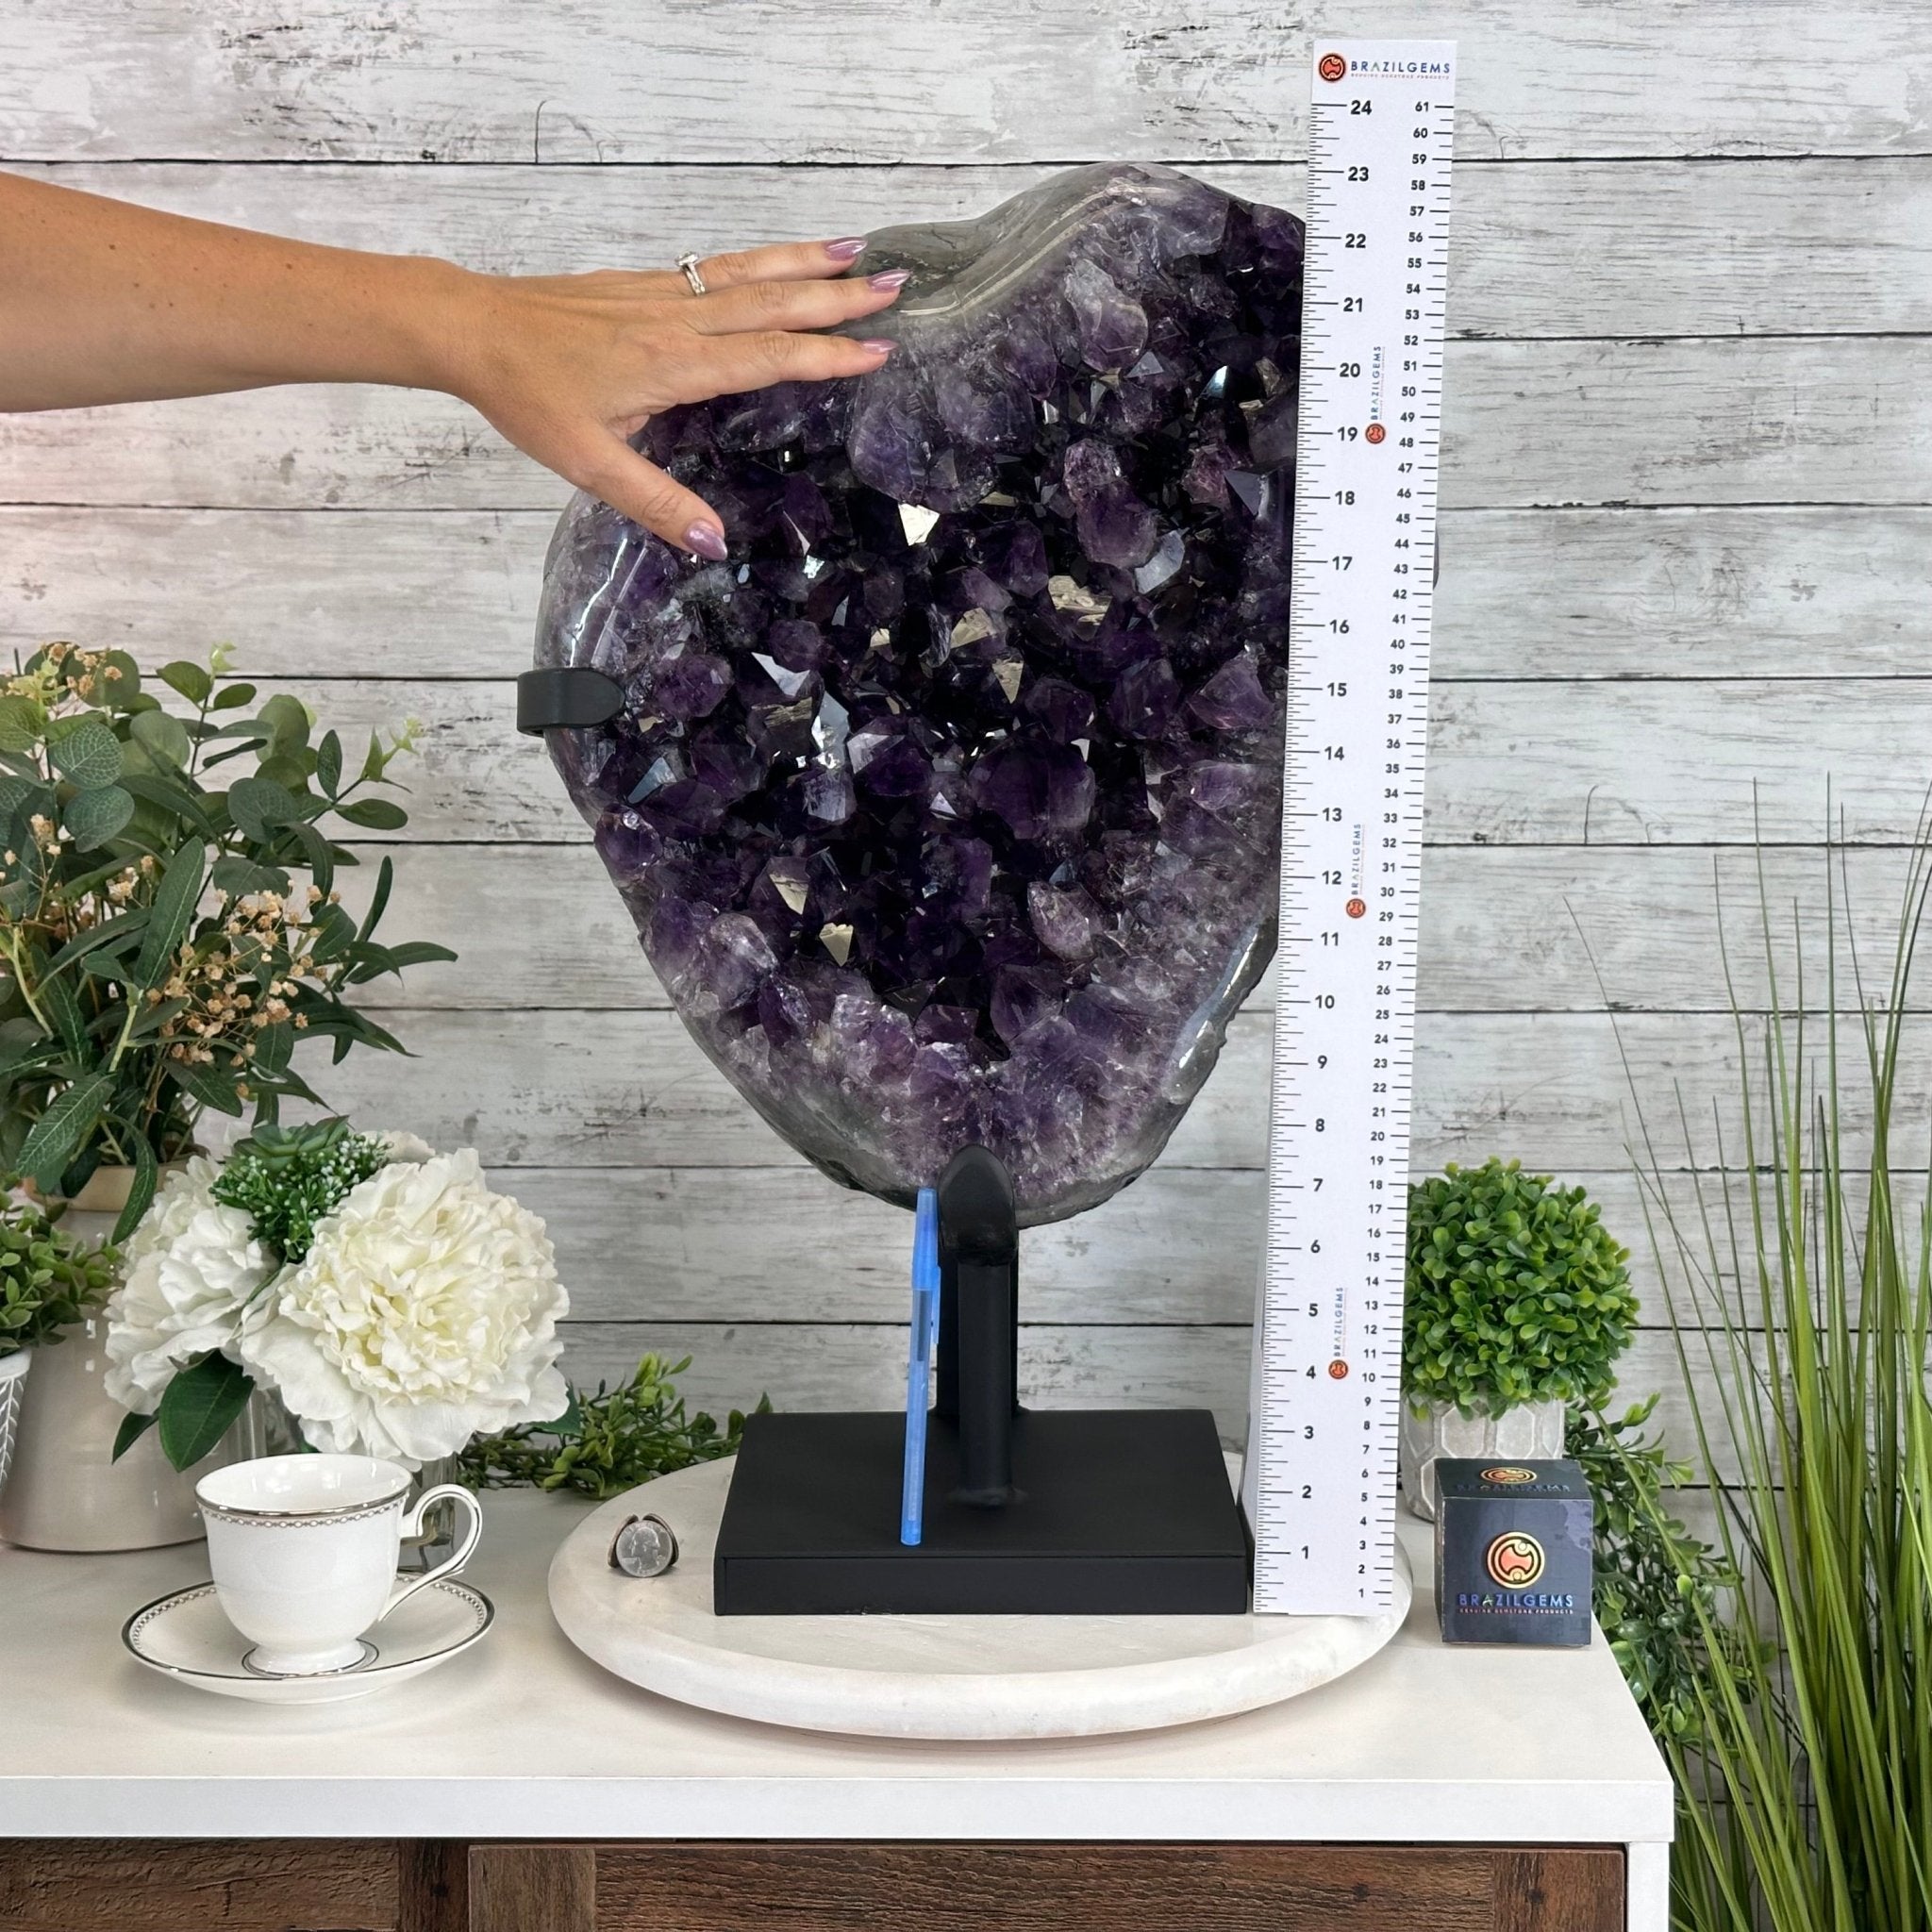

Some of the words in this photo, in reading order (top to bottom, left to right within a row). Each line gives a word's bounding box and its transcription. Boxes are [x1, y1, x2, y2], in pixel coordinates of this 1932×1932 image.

[1350, 60, 1450, 74] BRAZILGEMS
[1350, 99, 1373, 116] 24
[1414, 101, 1429, 112] 61
[1412, 126, 1428, 140] 60
[1411, 153, 1427, 165] 59
[1347, 165, 1370, 182] 23
[1410, 179, 1426, 192] 58
[1409, 205, 1425, 217] 57
[1344, 232, 1367, 249] 22
[1407, 231, 1424, 243] 56
[1407, 257, 1423, 269] 55
[1406, 283, 1421, 295] 54
[1342, 296, 1363, 313] 21
[1405, 308, 1420, 321] 53
[1403, 334, 1419, 346] 52
[1339, 362, 1361, 378] 20
[1403, 359, 1417, 372] 51
[1370, 345, 1382, 421] BRAZILGEMS
[1401, 386, 1417, 397] 50
[1399, 411, 1416, 423] 49
[1337, 425, 1358, 442] 19
[1398, 437, 1414, 449] 48
[1397, 462, 1413, 474] 47
[1334, 490, 1356, 506] 18
[1396, 488, 1412, 499] 46
[1395, 512, 1410, 525] 45
[1393, 538, 1409, 549] 44
[1332, 556, 1353, 571] 17
[1393, 563, 1408, 575] 43
[1392, 589, 1407, 600] 42
[1391, 613, 1407, 625] 41
[1329, 619, 1350, 635] 16
[1390, 639, 1406, 650] 40
[1389, 663, 1405, 675] 39
[1326, 682, 1347, 697] 15
[1388, 688, 1403, 700] 38
[1387, 713, 1403, 724] 37
[1386, 738, 1401, 749] 36
[1324, 745, 1345, 761] 14
[1385, 763, 1400, 774] 35
[1384, 788, 1399, 799] 34
[1322, 807, 1342, 823] 13
[1383, 812, 1398, 824] 33
[1382, 837, 1397, 849] 32
[1351, 824, 1361, 896] BRAZILGEMS
[1381, 861, 1395, 873] 31
[1322, 870, 1342, 886] 12
[1380, 886, 1395, 898] 30
[1378, 911, 1394, 923] 29
[1321, 931, 1339, 947] 11
[1377, 935, 1392, 947] 28
[1376, 960, 1392, 972] 27
[1375, 984, 1391, 996] 26
[1314, 994, 1335, 1009] 10
[1374, 1008, 1390, 1020] 25
[1374, 1033, 1389, 1044] 24
[1317, 1055, 1328, 1070] 9
[1373, 1058, 1388, 1069] 23
[1372, 1082, 1387, 1093] 22
[1372, 1107, 1386, 1118] 21
[1315, 1118, 1325, 1133] 8
[1370, 1130, 1386, 1141] 20
[1370, 1155, 1384, 1166] 19
[1312, 1177, 1324, 1192] 7
[1369, 1179, 1383, 1191] 18
[1368, 1204, 1383, 1214] 17
[1367, 1227, 1382, 1239] 16
[1309, 1239, 1322, 1254] 6
[1366, 1252, 1380, 1263] 15
[1365, 1275, 1379, 1287] 14
[1307, 1303, 1319, 1318] 5
[1364, 1300, 1379, 1311] 13
[1333, 1287, 1343, 1357] BRAZILGEMS
[1363, 1324, 1378, 1335] 12
[1363, 1348, 1376, 1359] 11
[1306, 1365, 1317, 1380] 4
[1361, 1372, 1376, 1383] 10
[1364, 1396, 1372, 1407] 9
[1363, 1420, 1371, 1431] 8
[1304, 1424, 1314, 1440] 3
[1362, 1443, 1371, 1455] 7
[1361, 1468, 1369, 1479] 6
[1301, 1484, 1312, 1499] 2
[1360, 1491, 1368, 1503] 5
[1359, 1516, 1368, 1526] 4
[1358, 1540, 1367, 1551] 3
[1301, 1545, 1309, 1560] 1
[1357, 1563, 1366, 1574] 2
[1357, 1588, 1364, 1598] 1
[1458, 1593, 1574, 1607] BRAZILGEMS
